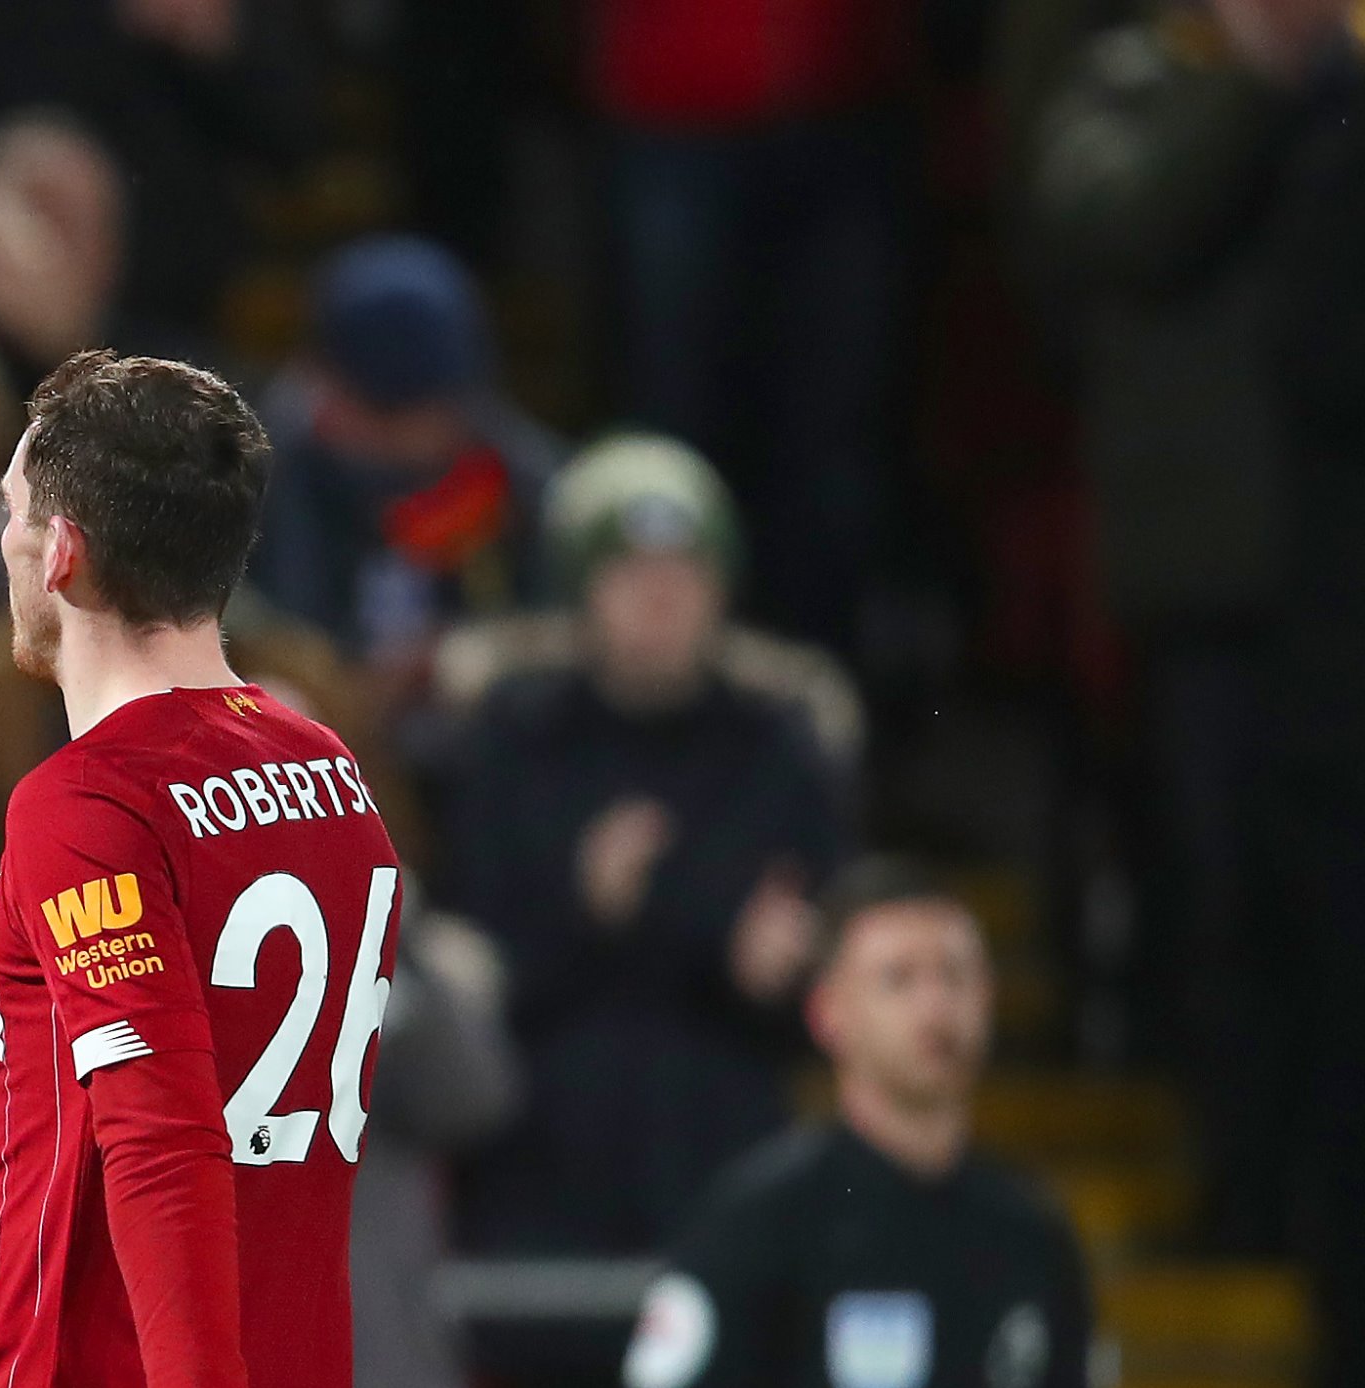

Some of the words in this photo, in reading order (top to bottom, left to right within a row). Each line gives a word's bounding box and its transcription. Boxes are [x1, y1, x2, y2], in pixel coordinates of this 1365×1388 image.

[40, 872, 143, 949] WU
[54, 932, 155, 976] Western
[86, 956, 164, 989] Union
[210, 867, 397, 1165] 26
